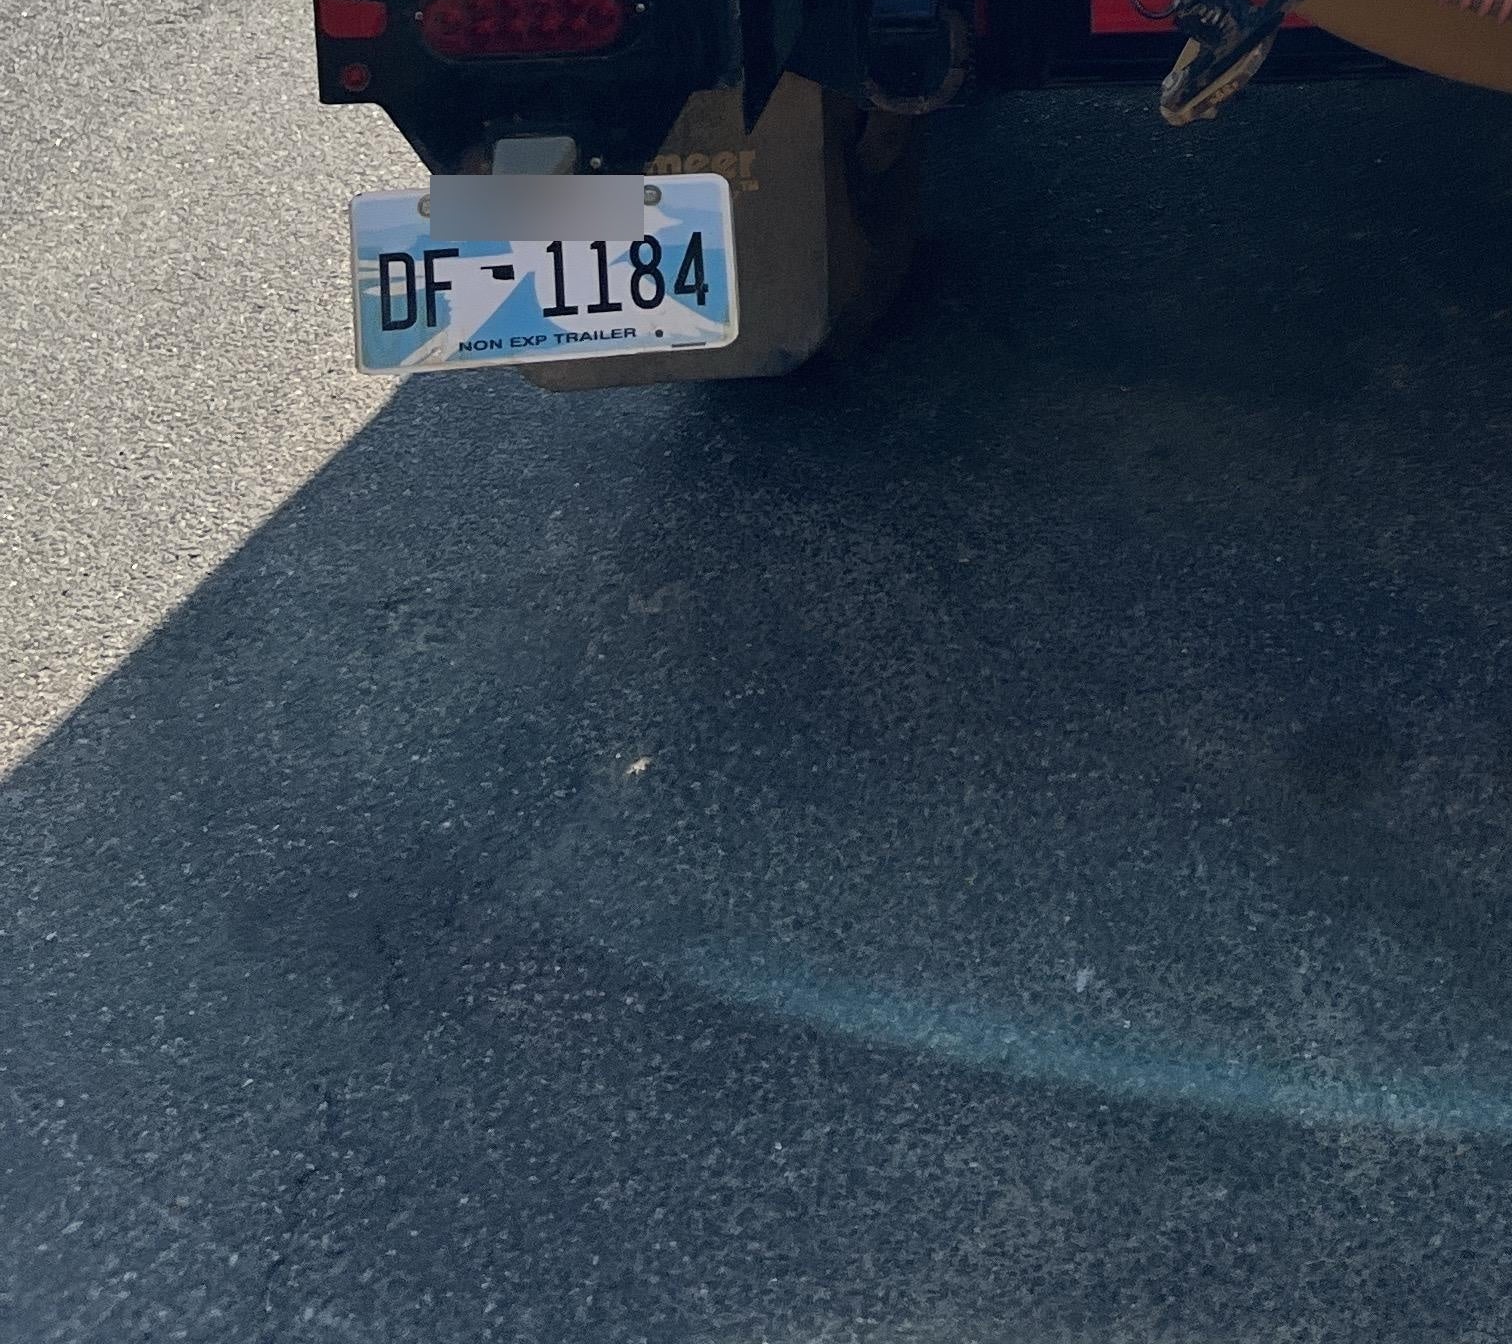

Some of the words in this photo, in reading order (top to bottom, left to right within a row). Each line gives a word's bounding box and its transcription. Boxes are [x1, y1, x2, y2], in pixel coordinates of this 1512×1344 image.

[378, 248, 459, 331] DF
[542, 231, 709, 318] 1184
[459, 338, 503, 352] NON
[510, 334, 548, 348] EXP
[553, 327, 638, 345] TRAILER
